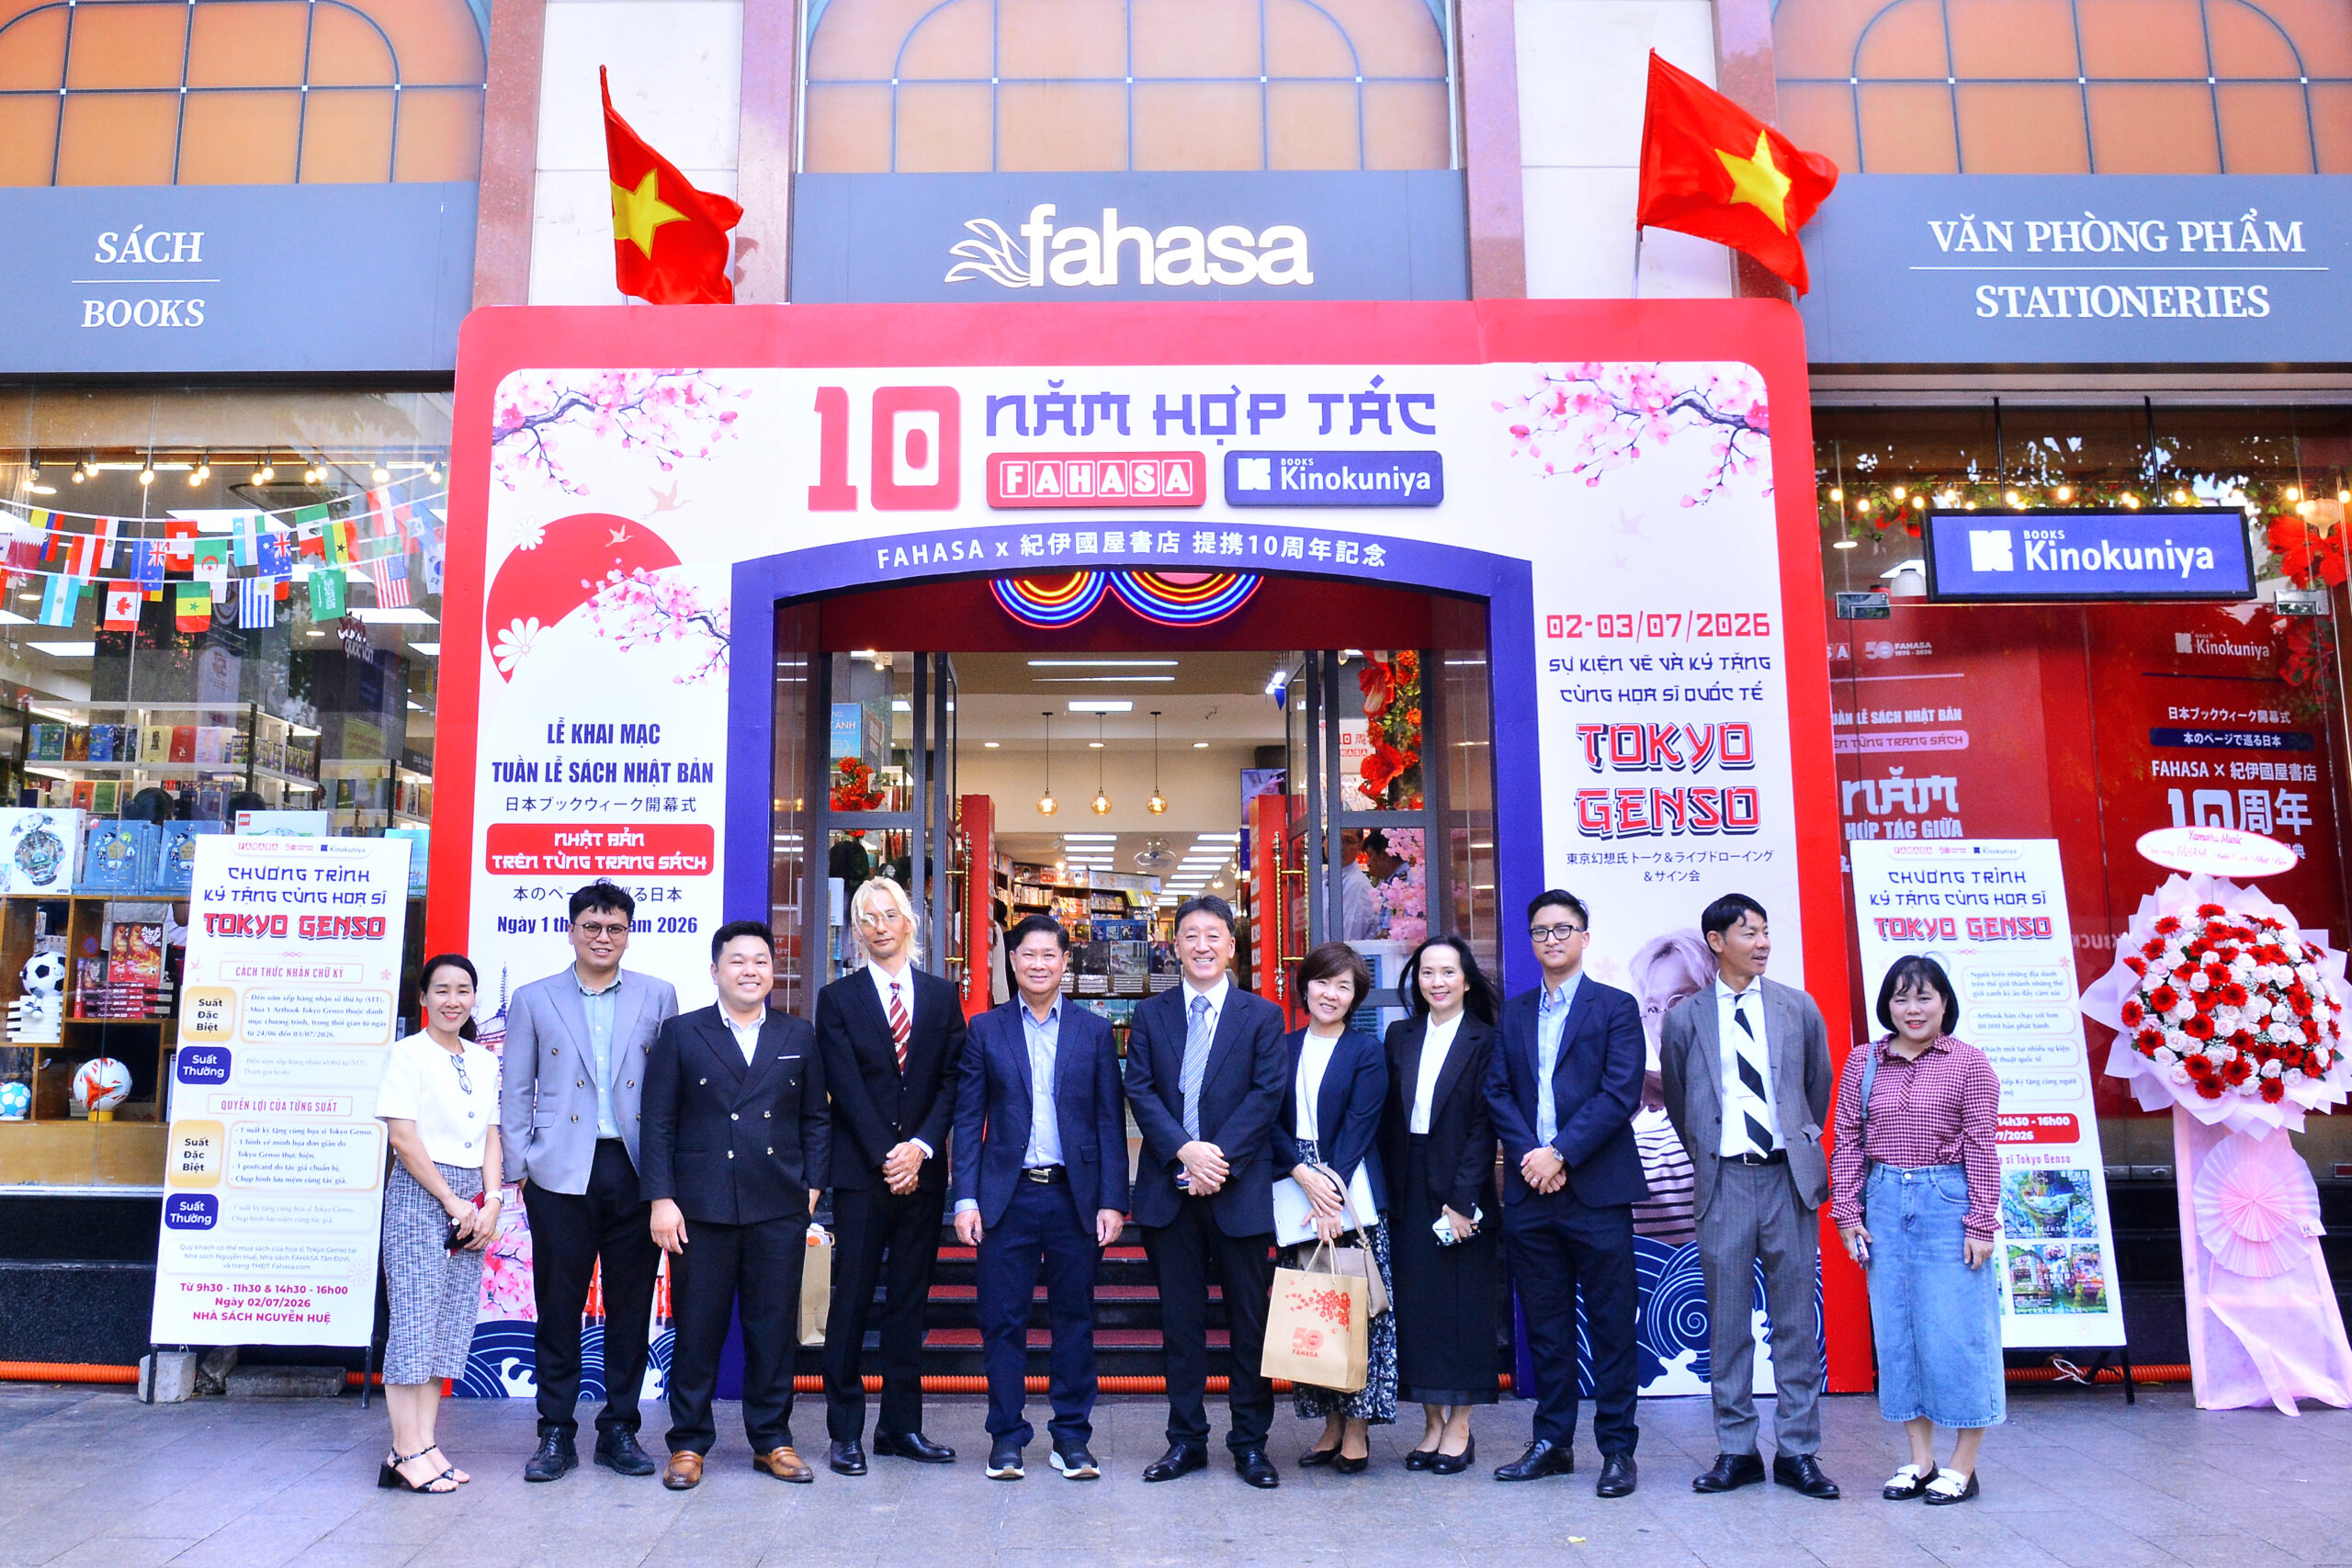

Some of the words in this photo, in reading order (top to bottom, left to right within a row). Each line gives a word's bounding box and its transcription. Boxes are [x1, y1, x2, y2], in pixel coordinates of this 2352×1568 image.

[1928, 213, 2014, 253] VĂN
[2025, 211, 2168, 253] PHÒNG
[2177, 209, 2305, 253] PHẨM
[95, 224, 204, 264] SÁCH
[1021, 204, 1314, 287] fahasa
[1975, 286, 2270, 318] STATIONERIES
[82, 299, 205, 327] BOOKS
[987, 378, 1131, 436] NĂM
[1153, 385, 1285, 446] HỢP
[1308, 374, 1436, 436] TÁC
[808, 386, 961, 512] 10
[1280, 457, 1315, 467] BOOKS
[1001, 460, 1193, 498] FAHASA
[1280, 465, 1431, 497] Kinokuniya
[2023, 530, 2065, 540] BOOKS
[876, 540, 983, 570] FAHASA
[1020, 531, 1182, 560] 紀伊國屋書店
[1192, 531, 1387, 569] 提携10周年記念
[2026, 539, 2214, 578] Kinokuniya
[1546, 610, 1770, 643] 02-03/07/2026
[2196, 639, 2270, 660] Kinokuniya
[1549, 656, 1573, 675] SỰ
[1580, 655, 1623, 674] KIỆN
[1629, 655, 1653, 671] VẼ
[1659, 652, 1683, 671] VÀ
[1690, 652, 1713, 671] KÝ
[1719, 652, 1770, 673] TẶNG
[1560, 684, 1612, 702] CÙNG
[1663, 684, 1679, 702] SĨ
[1685, 681, 1734, 703] QUỐC
[1739, 681, 1763, 701] TẾ
[1871, 709, 1902, 724] SÁCH
[1905, 708, 1935, 725] NHẬT
[1939, 706, 1962, 721] BẢN
[548, 716, 565, 744] LỄ
[571, 724, 614, 744] KHAI
[620, 724, 661, 748] MẠC
[1888, 737, 1928, 748] TRANG
[1930, 733, 1963, 746] SÁCH
[1575, 721, 1756, 774] TOKYO
[492, 755, 537, 783] TUẦN
[545, 755, 562, 783] LỄ
[569, 759, 617, 783] SÁCH
[624, 759, 671, 787] NHẬT
[677, 757, 713, 783] BẢN
[2152, 761, 2209, 777] FAHASA
[2231, 761, 2317, 782] 紀伊國屋書店
[1841, 765, 1960, 816] NĂM
[506, 796, 696, 813] 日本ブックウィーク開幕式
[1574, 785, 1760, 840] GENSO
[1883, 818, 1917, 839] TÁC
[1922, 817, 1963, 838] GIỮA
[554, 830, 604, 850] NHẬT
[607, 827, 645, 847] BẢN
[492, 853, 538, 869] TRÊN
[543, 851, 591, 870] TỪNG
[594, 855, 654, 870] TRANG
[658, 851, 707, 871] SÁCH
[228, 865, 307, 882] CHƯƠNG
[314, 865, 370, 882] TRÌNH
[1889, 869, 1965, 884] CHƯƠNG
[1972, 867, 2026, 884] TRÌNH
[204, 886, 225, 901] KÝ
[232, 886, 277, 905] TẶNG
[282, 887, 327, 904] CÙNG
[371, 890, 387, 905] SĨ
[513, 886, 683, 903] 本のペーる日本
[1870, 890, 1890, 906] KÝ
[1895, 889, 1939, 908] TẶNG
[1945, 889, 1988, 905] CÙNG
[2032, 890, 2046, 905] SĨ
[204, 913, 288, 939] TOKYO
[298, 915, 386, 941] GENSO
[497, 916, 537, 935] Ngày
[541, 917, 548, 932] 1
[657, 917, 698, 934] 2026
[1873, 917, 1957, 941] TOKYO
[1966, 917, 2053, 942] GENSO
[236, 964, 257, 976] CÁCH
[198, 998, 223, 1007] Suất
[198, 1011, 219, 1021] Đặc
[197, 1022, 219, 1032] Biệt
[192, 1055, 217, 1065] Suất
[183, 1066, 225, 1078] Thường
[1997, 1117, 2030, 1127] 14h30
[2037, 1116, 2071, 1126] 16h00
[185, 1137, 209, 1146] Suất
[184, 1151, 205, 1161] Đặc
[2017, 1154, 2041, 1166] Tokyo
[2044, 1154, 2071, 1164] Genso
[183, 1163, 205, 1173] Biệt
[179, 1201, 204, 1211] Suất
[171, 1213, 212, 1225] Thường
[180, 1282, 192, 1292] Từ
[197, 1283, 223, 1292] 9h30
[233, 1284, 261, 1293] 11h30
[265, 1284, 272, 1293] &
[276, 1285, 306, 1293] 14h30
[317, 1286, 348, 1295] 16h00
[215, 1297, 243, 1308] Ngày
[247, 1298, 311, 1309] 02/07/2026
[193, 1309, 218, 1321] NHÀ
[221, 1309, 253, 1321] SÁCH
[256, 1309, 302, 1323] NGUYỄN
[307, 1311, 332, 1325] HUỆ
[1292, 1348, 1318, 1358] FAHASA
